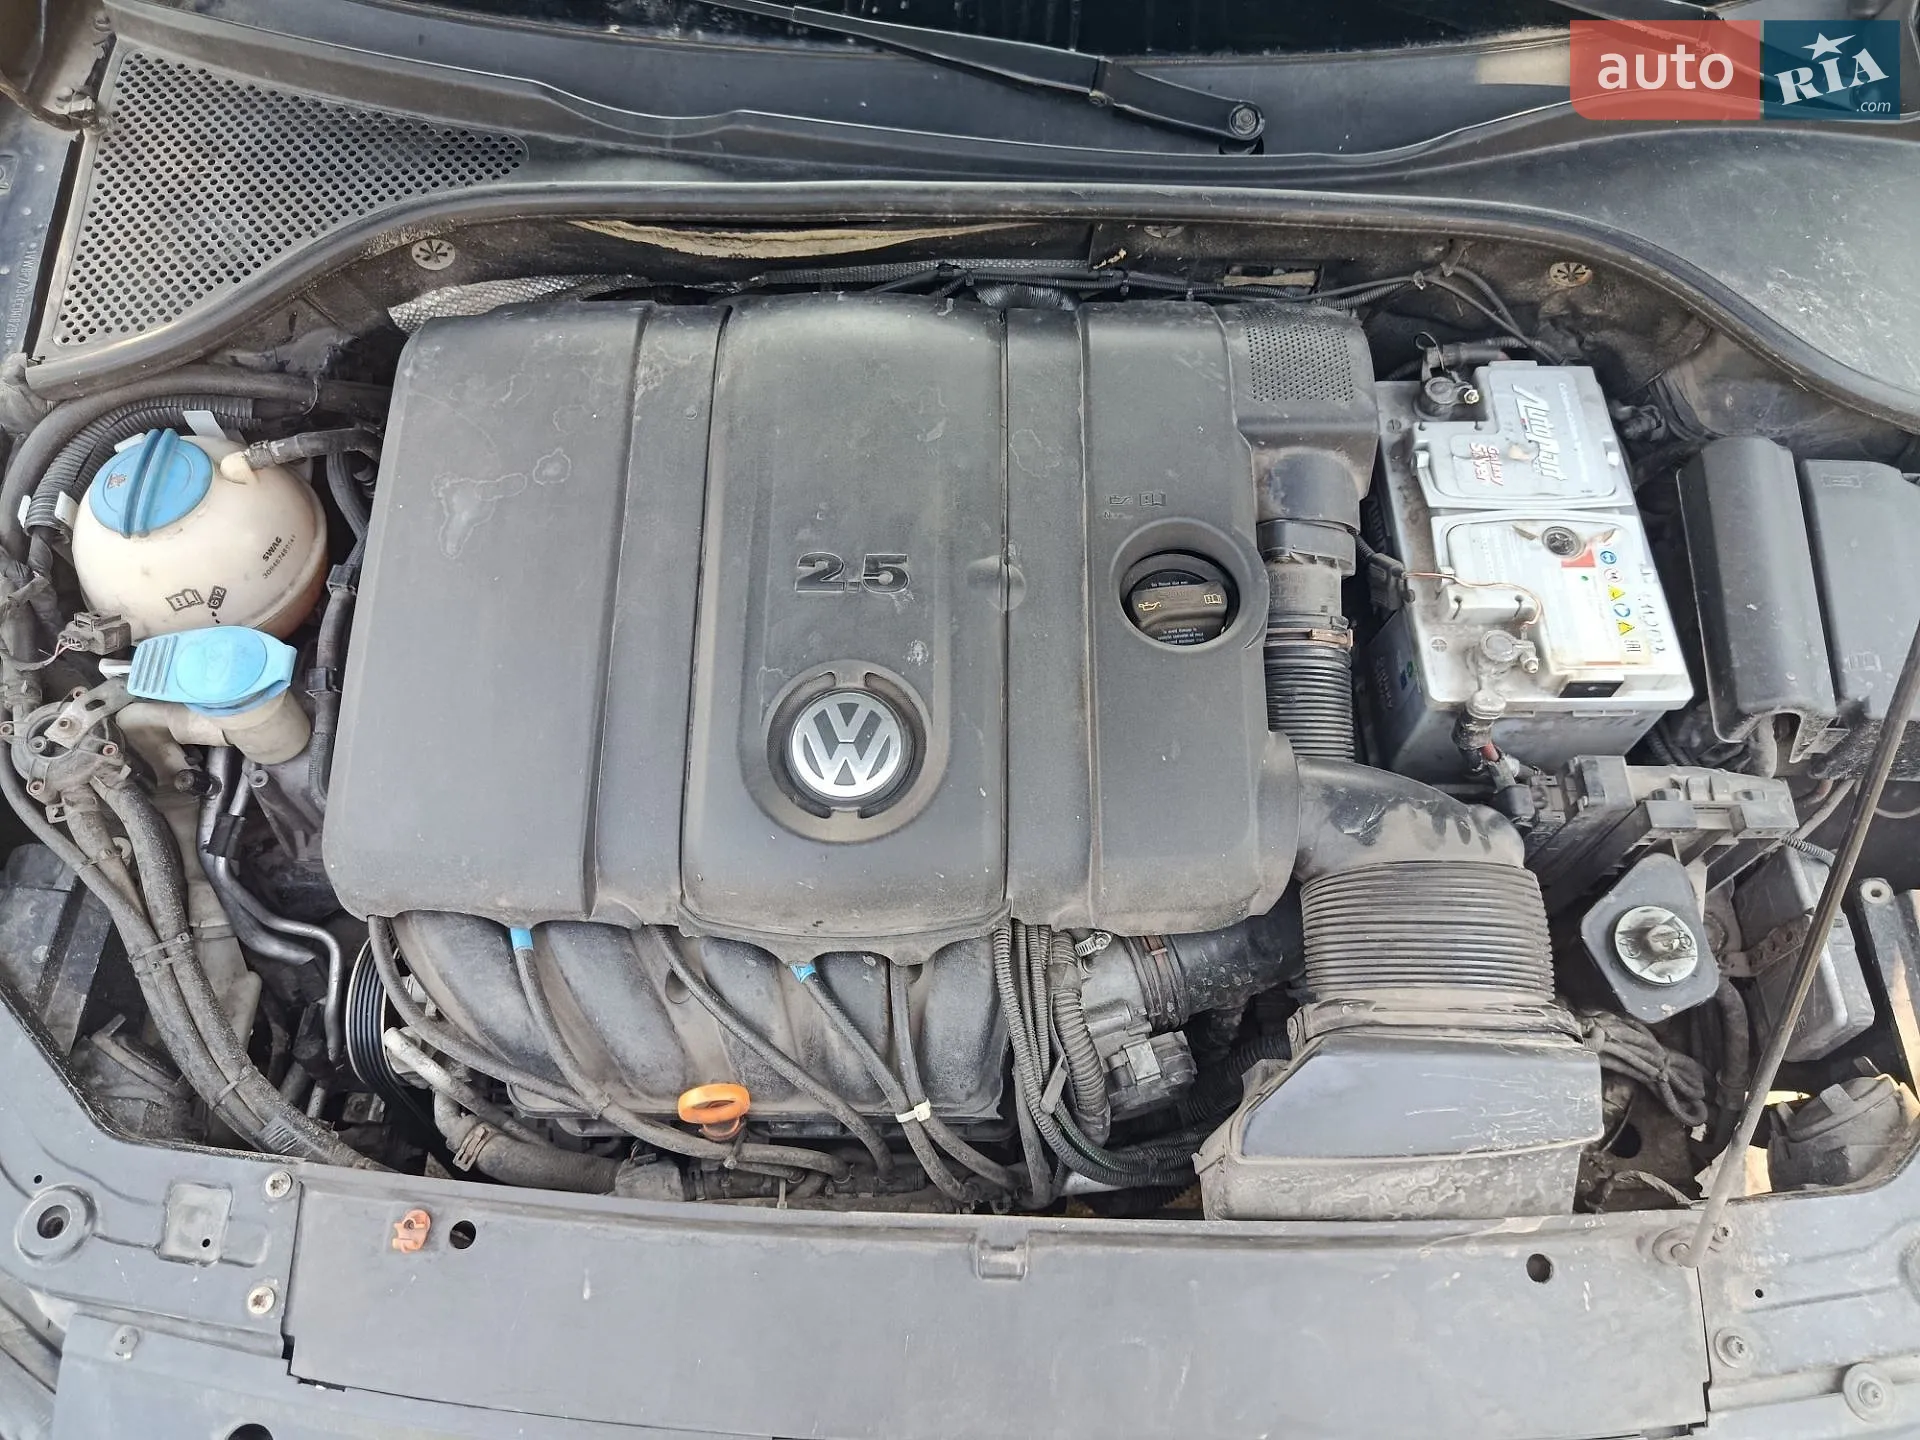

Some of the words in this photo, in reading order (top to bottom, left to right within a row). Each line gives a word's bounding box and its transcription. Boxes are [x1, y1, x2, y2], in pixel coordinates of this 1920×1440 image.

[262, 536, 282, 562] SWAG
[795, 552, 910, 594] 2.5
[211, 587, 226, 607] G12
